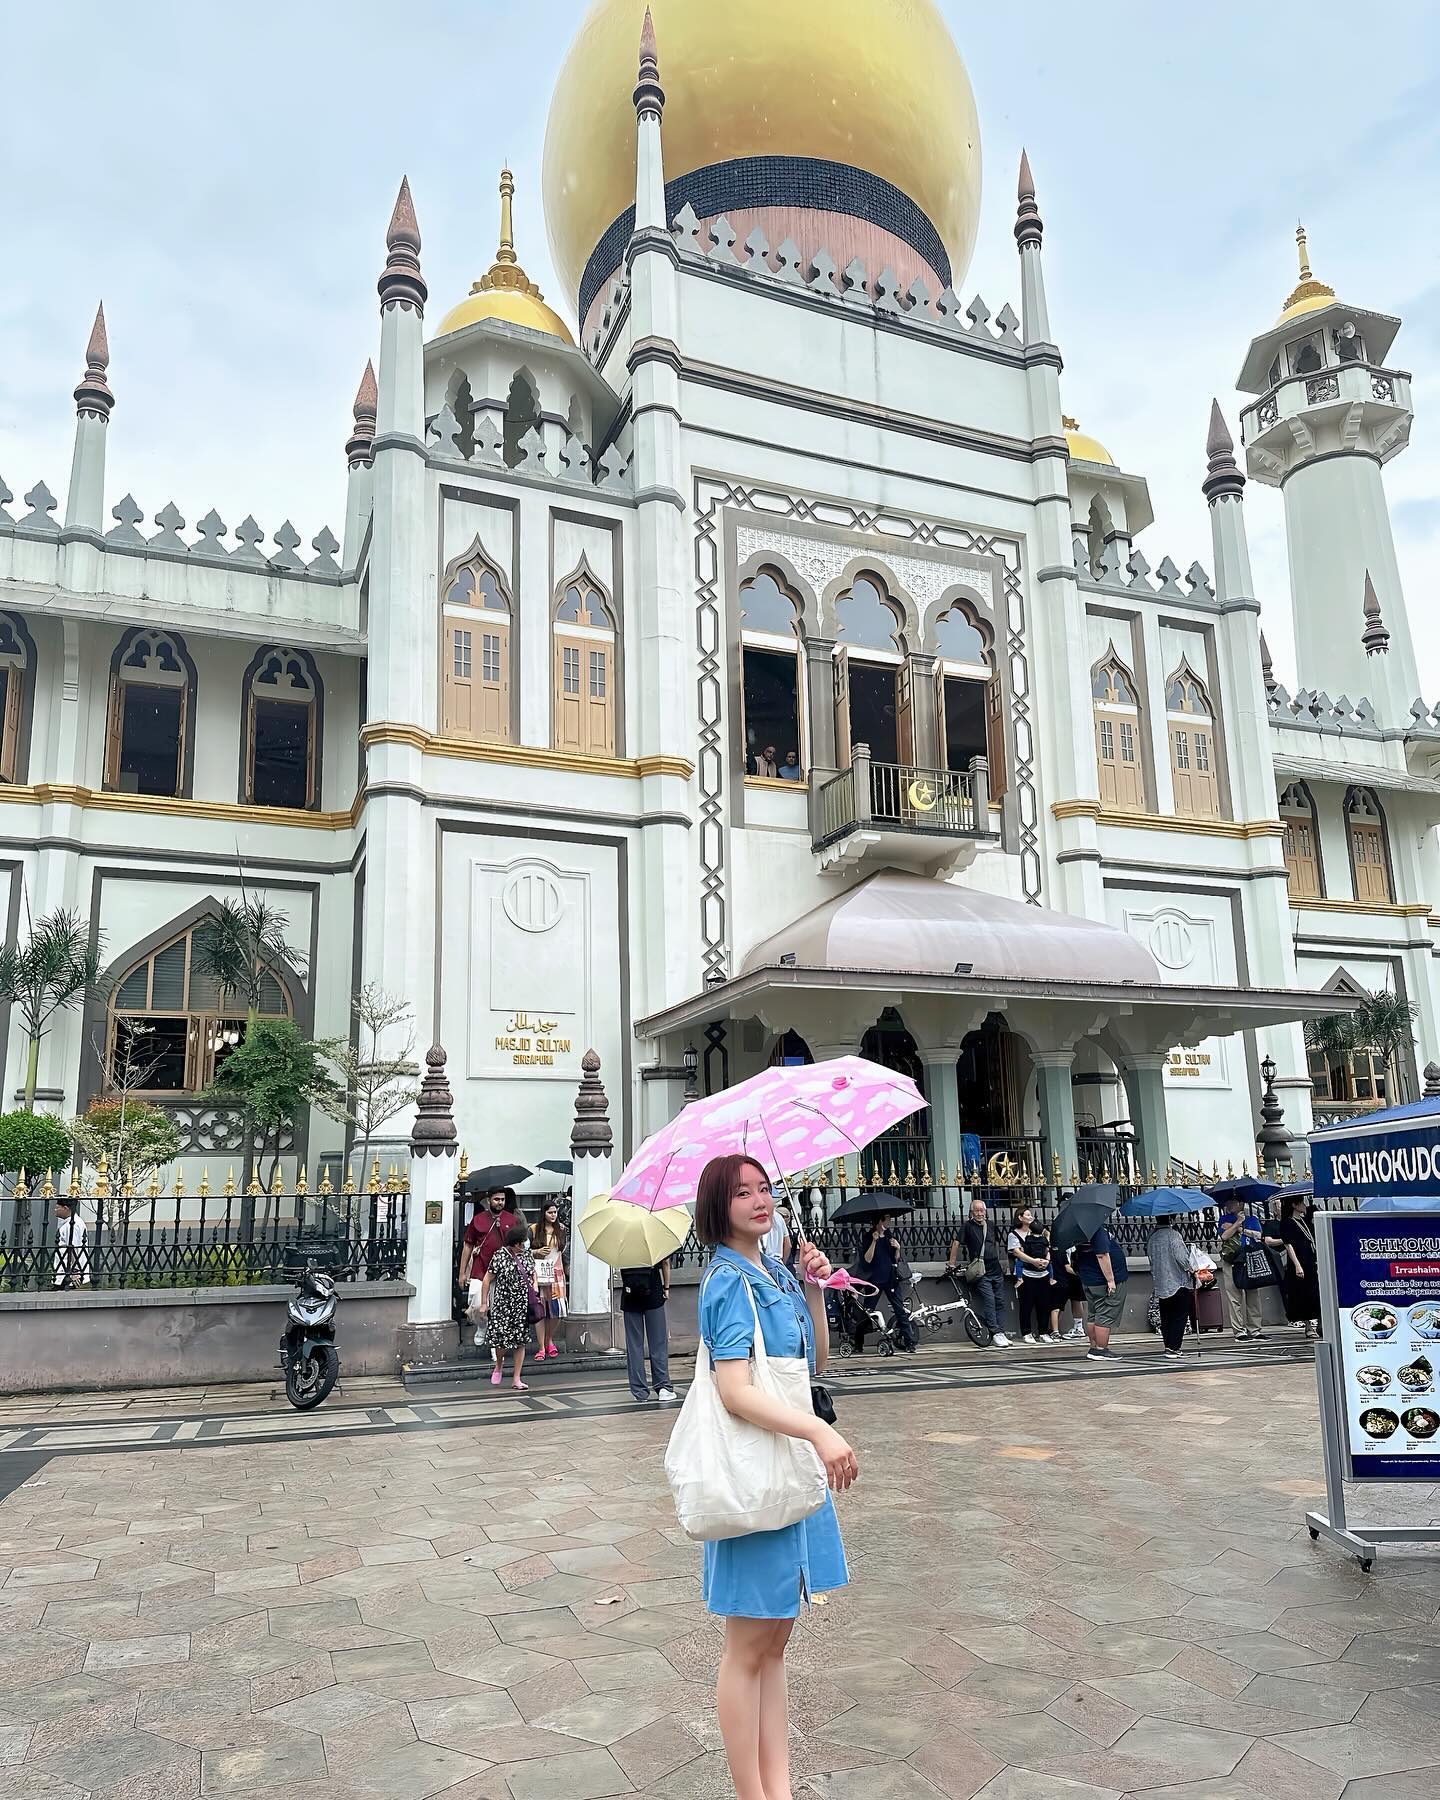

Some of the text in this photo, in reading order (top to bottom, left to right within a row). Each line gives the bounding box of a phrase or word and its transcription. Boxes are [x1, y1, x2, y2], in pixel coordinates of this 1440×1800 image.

[495, 1037, 571, 1053] MASJID SULTAN
[513, 1054, 554, 1065] SINGAPURA
[1185, 1054, 1211, 1065] SULTAN
[1360, 1280, 1384, 1288] Come
[1366, 1288, 1405, 1296] authentic
